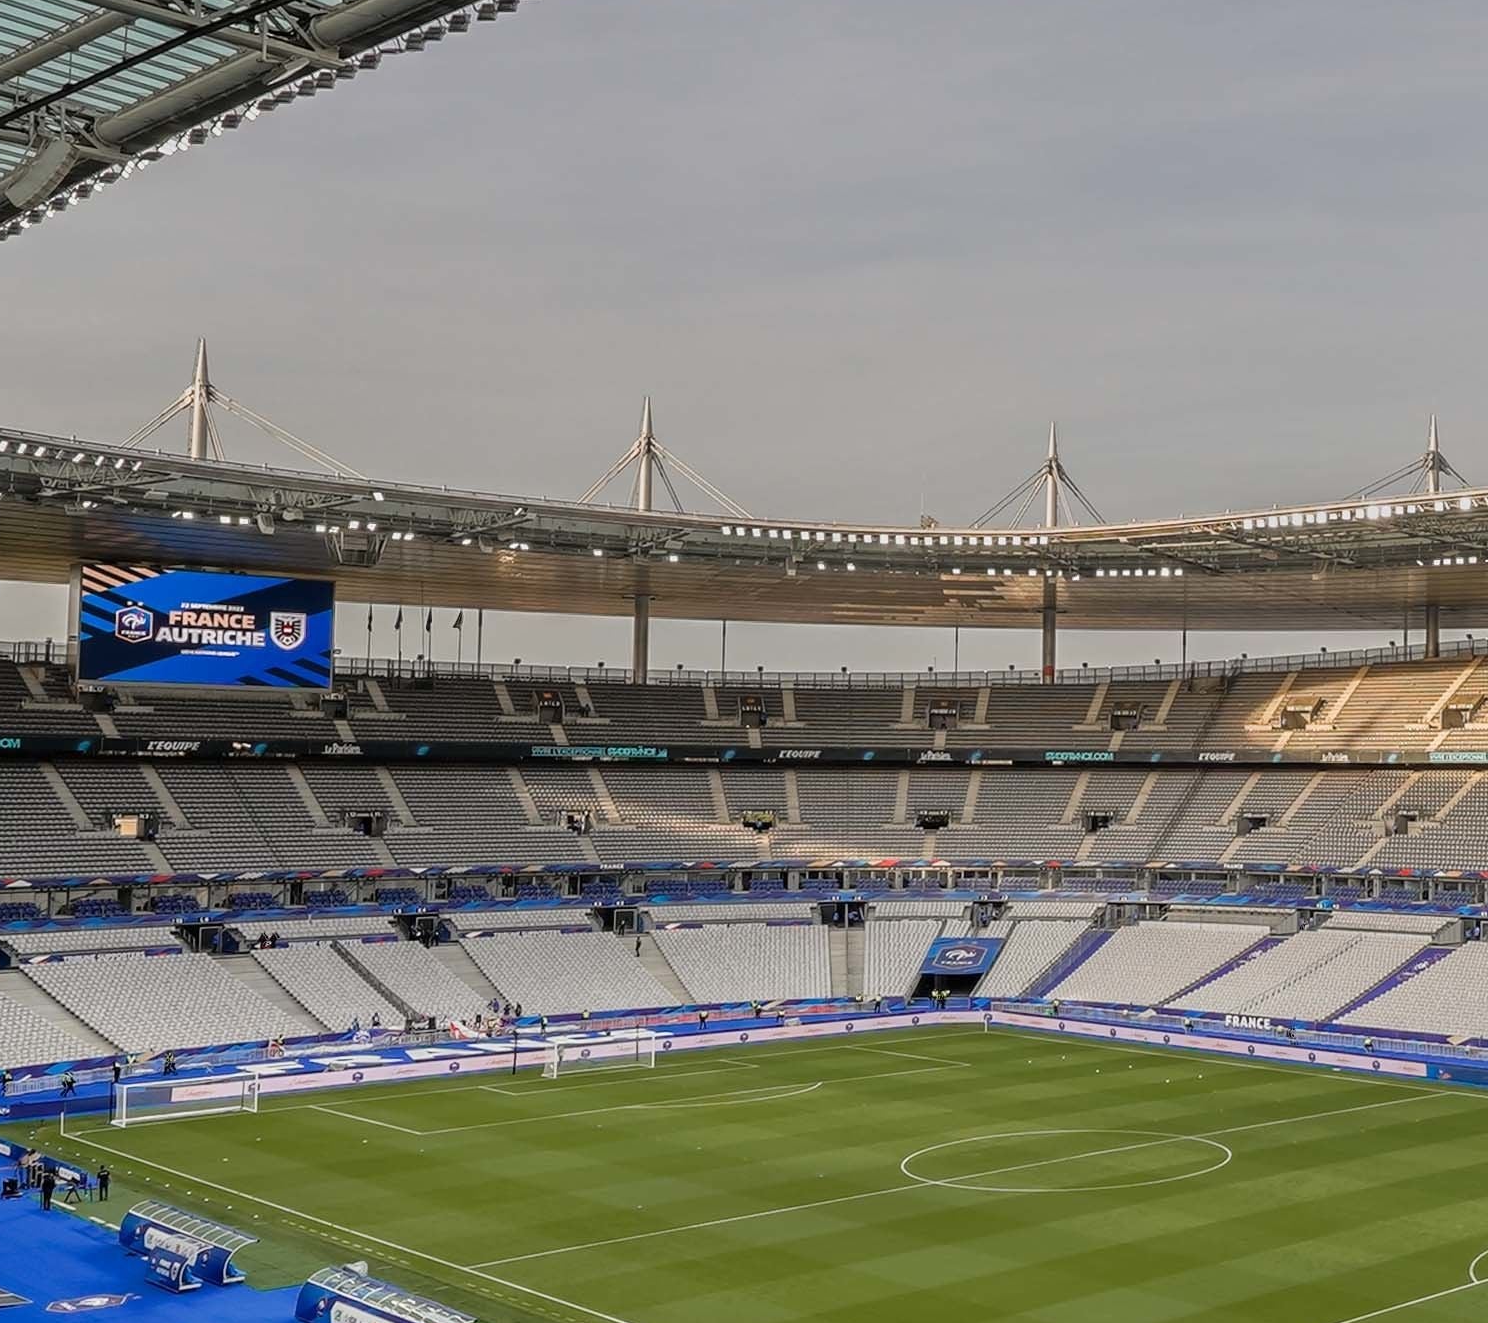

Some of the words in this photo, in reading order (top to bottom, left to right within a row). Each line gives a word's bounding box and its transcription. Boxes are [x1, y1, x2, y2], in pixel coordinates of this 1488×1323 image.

[168, 610, 255, 629] FRANCE
[155, 626, 265, 647] AUTRICHE
[1224, 1014, 1271, 1030] FRANCE
